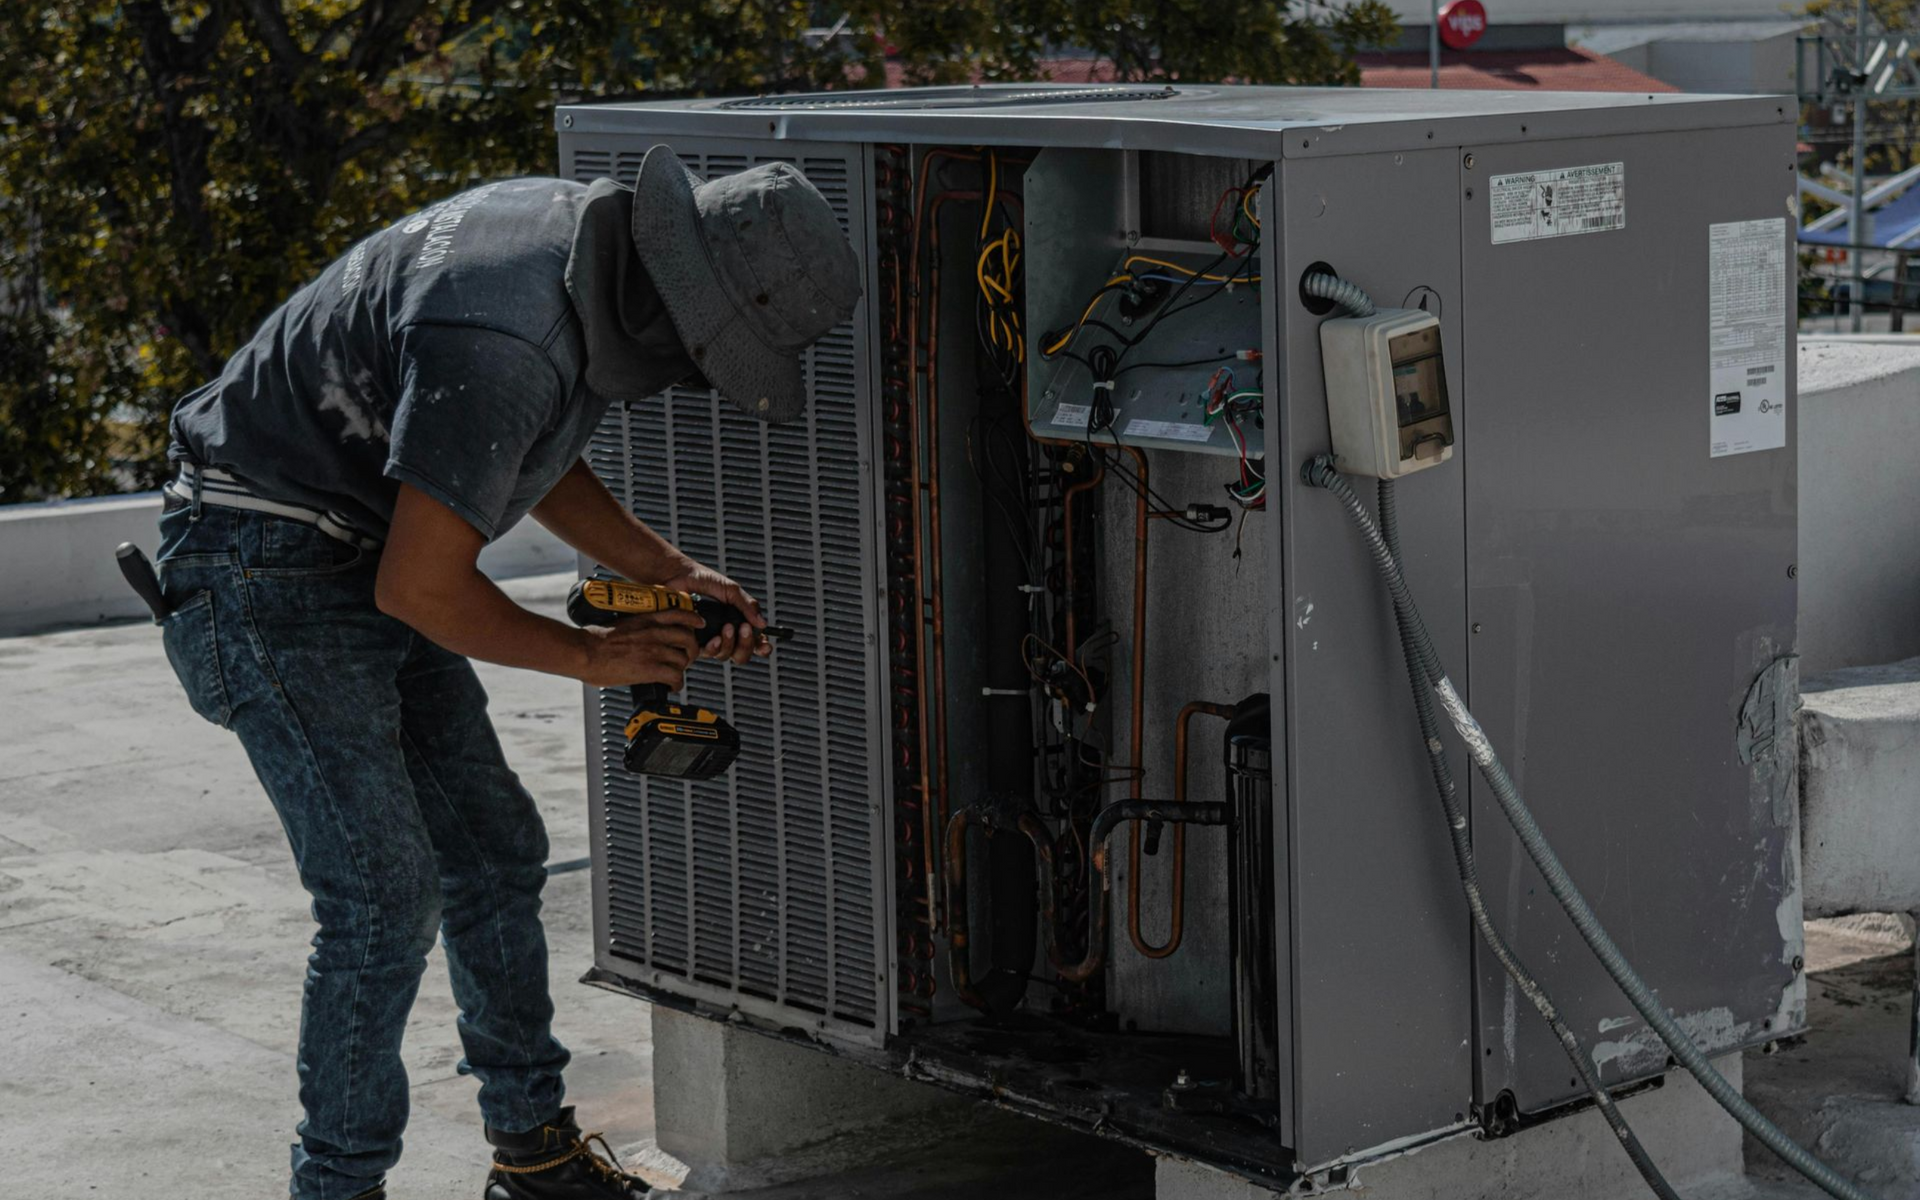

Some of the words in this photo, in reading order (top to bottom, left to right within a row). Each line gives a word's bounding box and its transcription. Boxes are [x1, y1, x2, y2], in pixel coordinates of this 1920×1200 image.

[1448, 14, 1482, 37] vips
[1567, 166, 1616, 178] AVERTISSEMENT
[1504, 175, 1536, 185] WARNING
